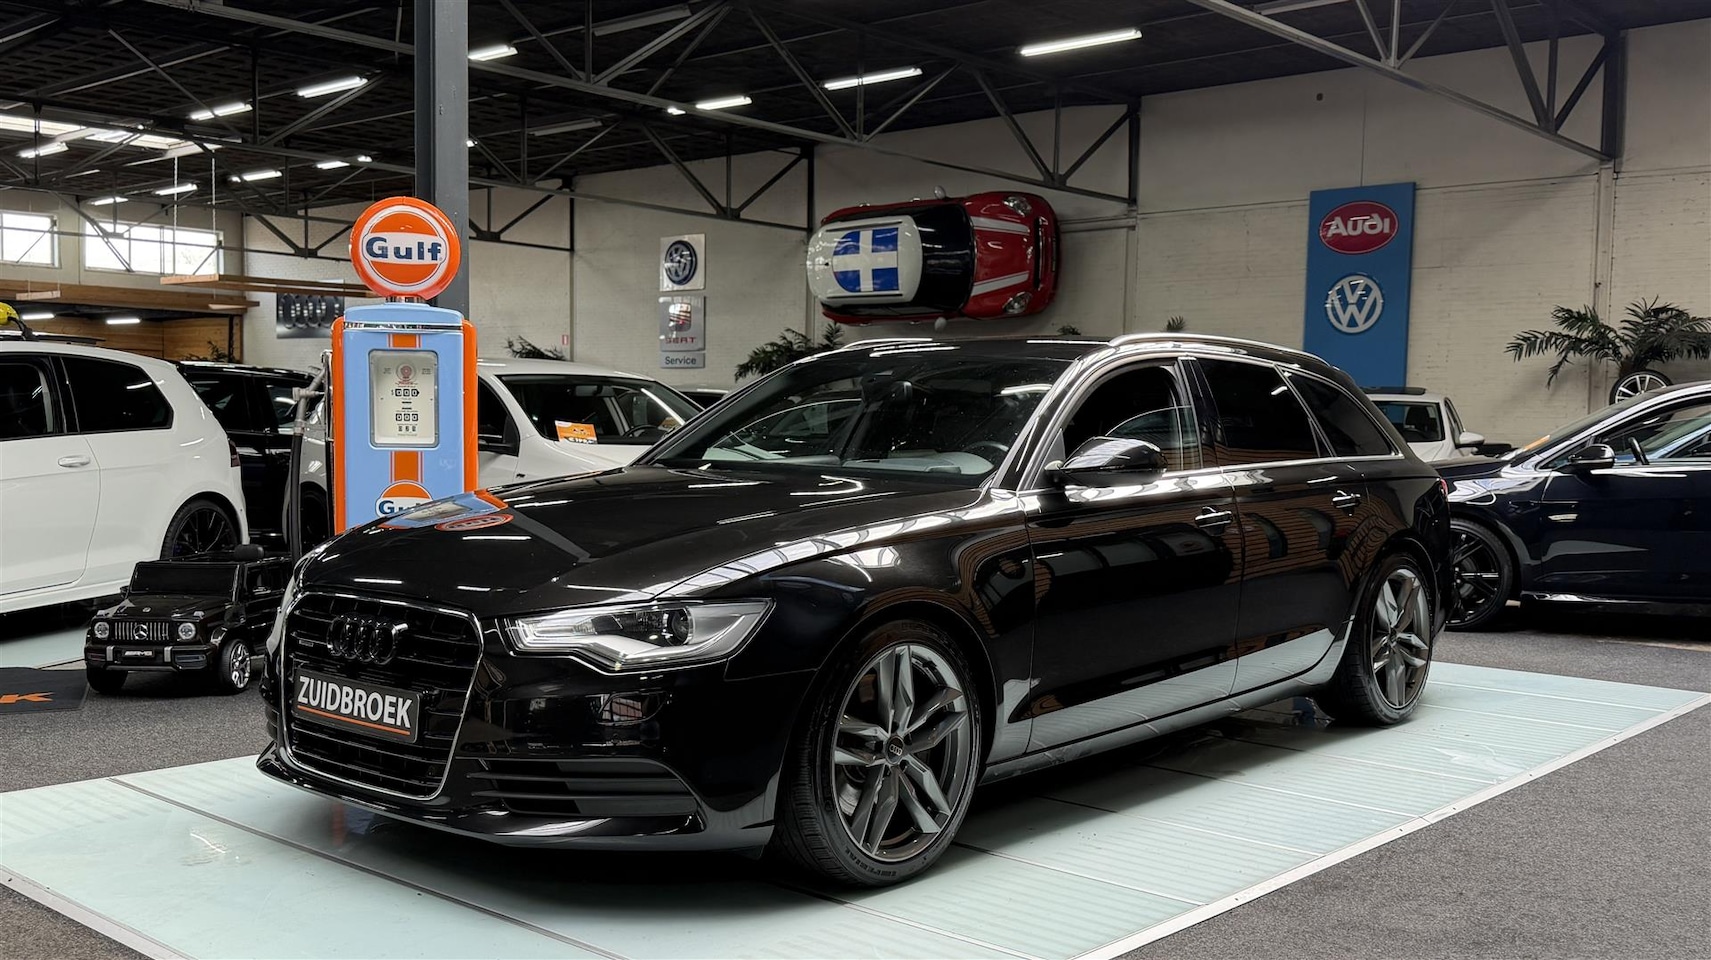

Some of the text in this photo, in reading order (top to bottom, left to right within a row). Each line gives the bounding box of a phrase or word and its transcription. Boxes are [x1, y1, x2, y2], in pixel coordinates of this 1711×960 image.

[366, 236, 442, 261] Gulf
[665, 355, 697, 365] Service
[297, 675, 413, 729] ZUIDBROEK
